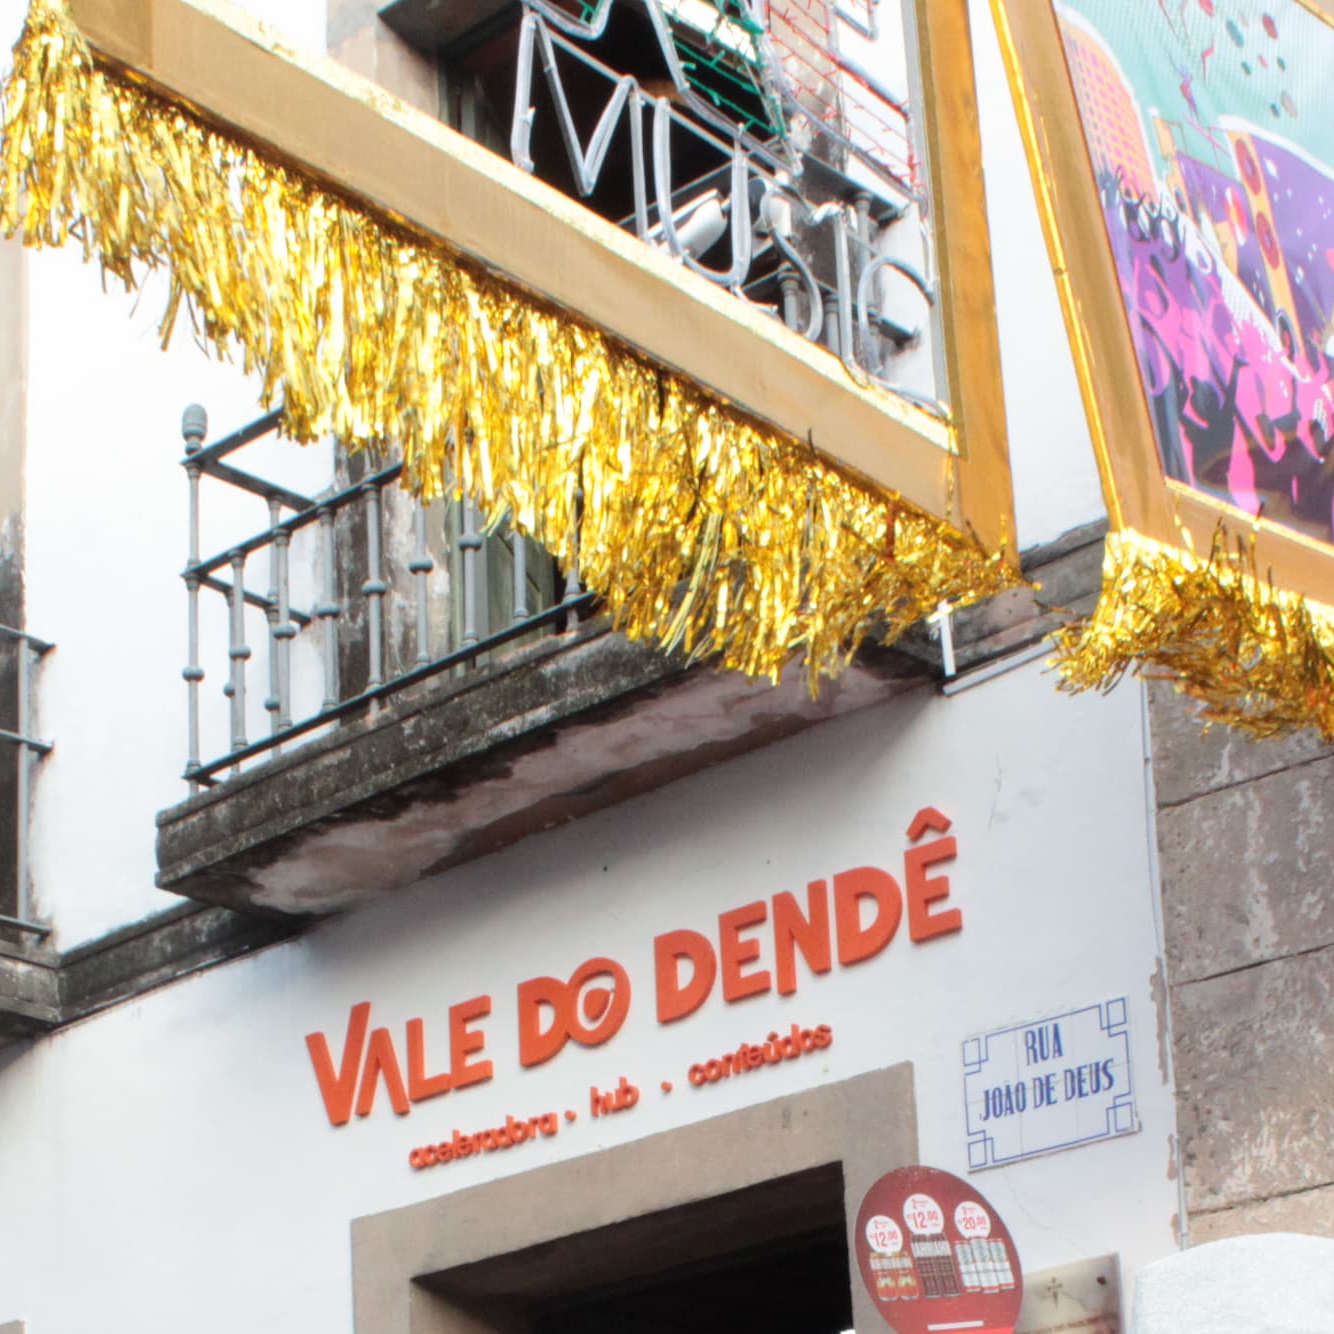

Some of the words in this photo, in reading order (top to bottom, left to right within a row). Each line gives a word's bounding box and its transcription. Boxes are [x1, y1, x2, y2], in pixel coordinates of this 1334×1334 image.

[305, 994, 494, 1127] VALE
[517, 957, 631, 1068] DO
[654, 806, 963, 1026] DENDÊ
[409, 1111, 559, 1171] aceleradora
[590, 1077, 641, 1117] hub
[688, 1024, 833, 1088] conteúdos
[981, 1077, 1028, 1122] JOÃO
[1033, 1074, 1057, 1111] DE
[1064, 1058, 1116, 1103] DEUS
[1024, 1023, 1064, 1067] RUA
